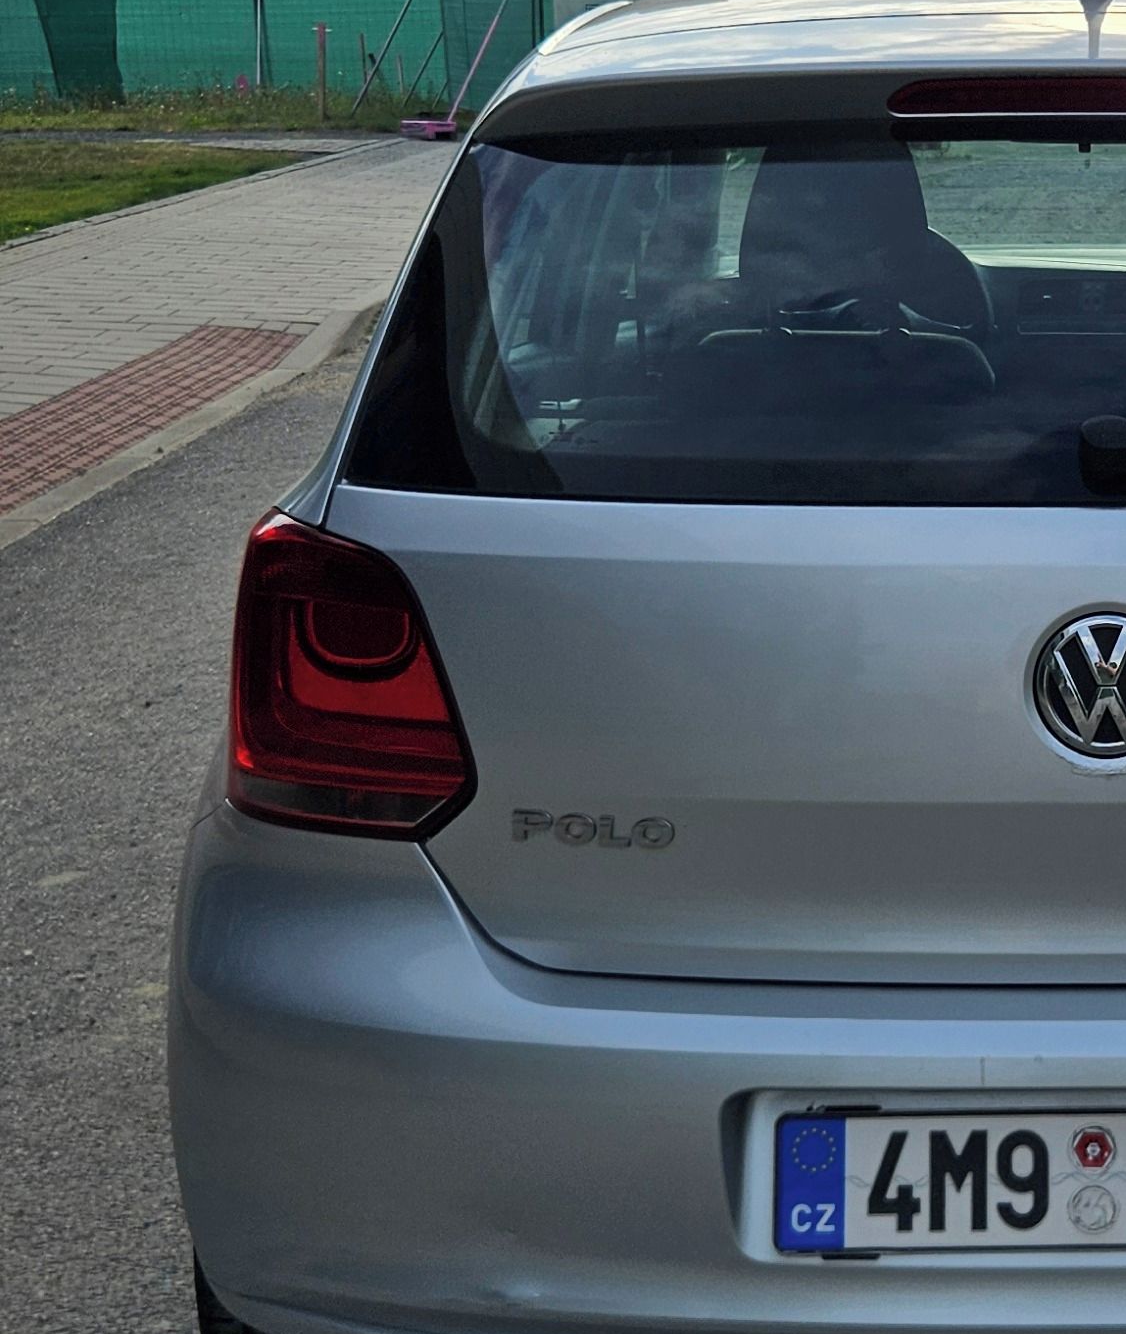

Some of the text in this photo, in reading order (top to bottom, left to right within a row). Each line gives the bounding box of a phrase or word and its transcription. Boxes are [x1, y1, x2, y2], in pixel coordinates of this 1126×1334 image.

[511, 807, 676, 849] POLO
[867, 1128, 1050, 1233] 4M9
[790, 1202, 836, 1233] CZ
